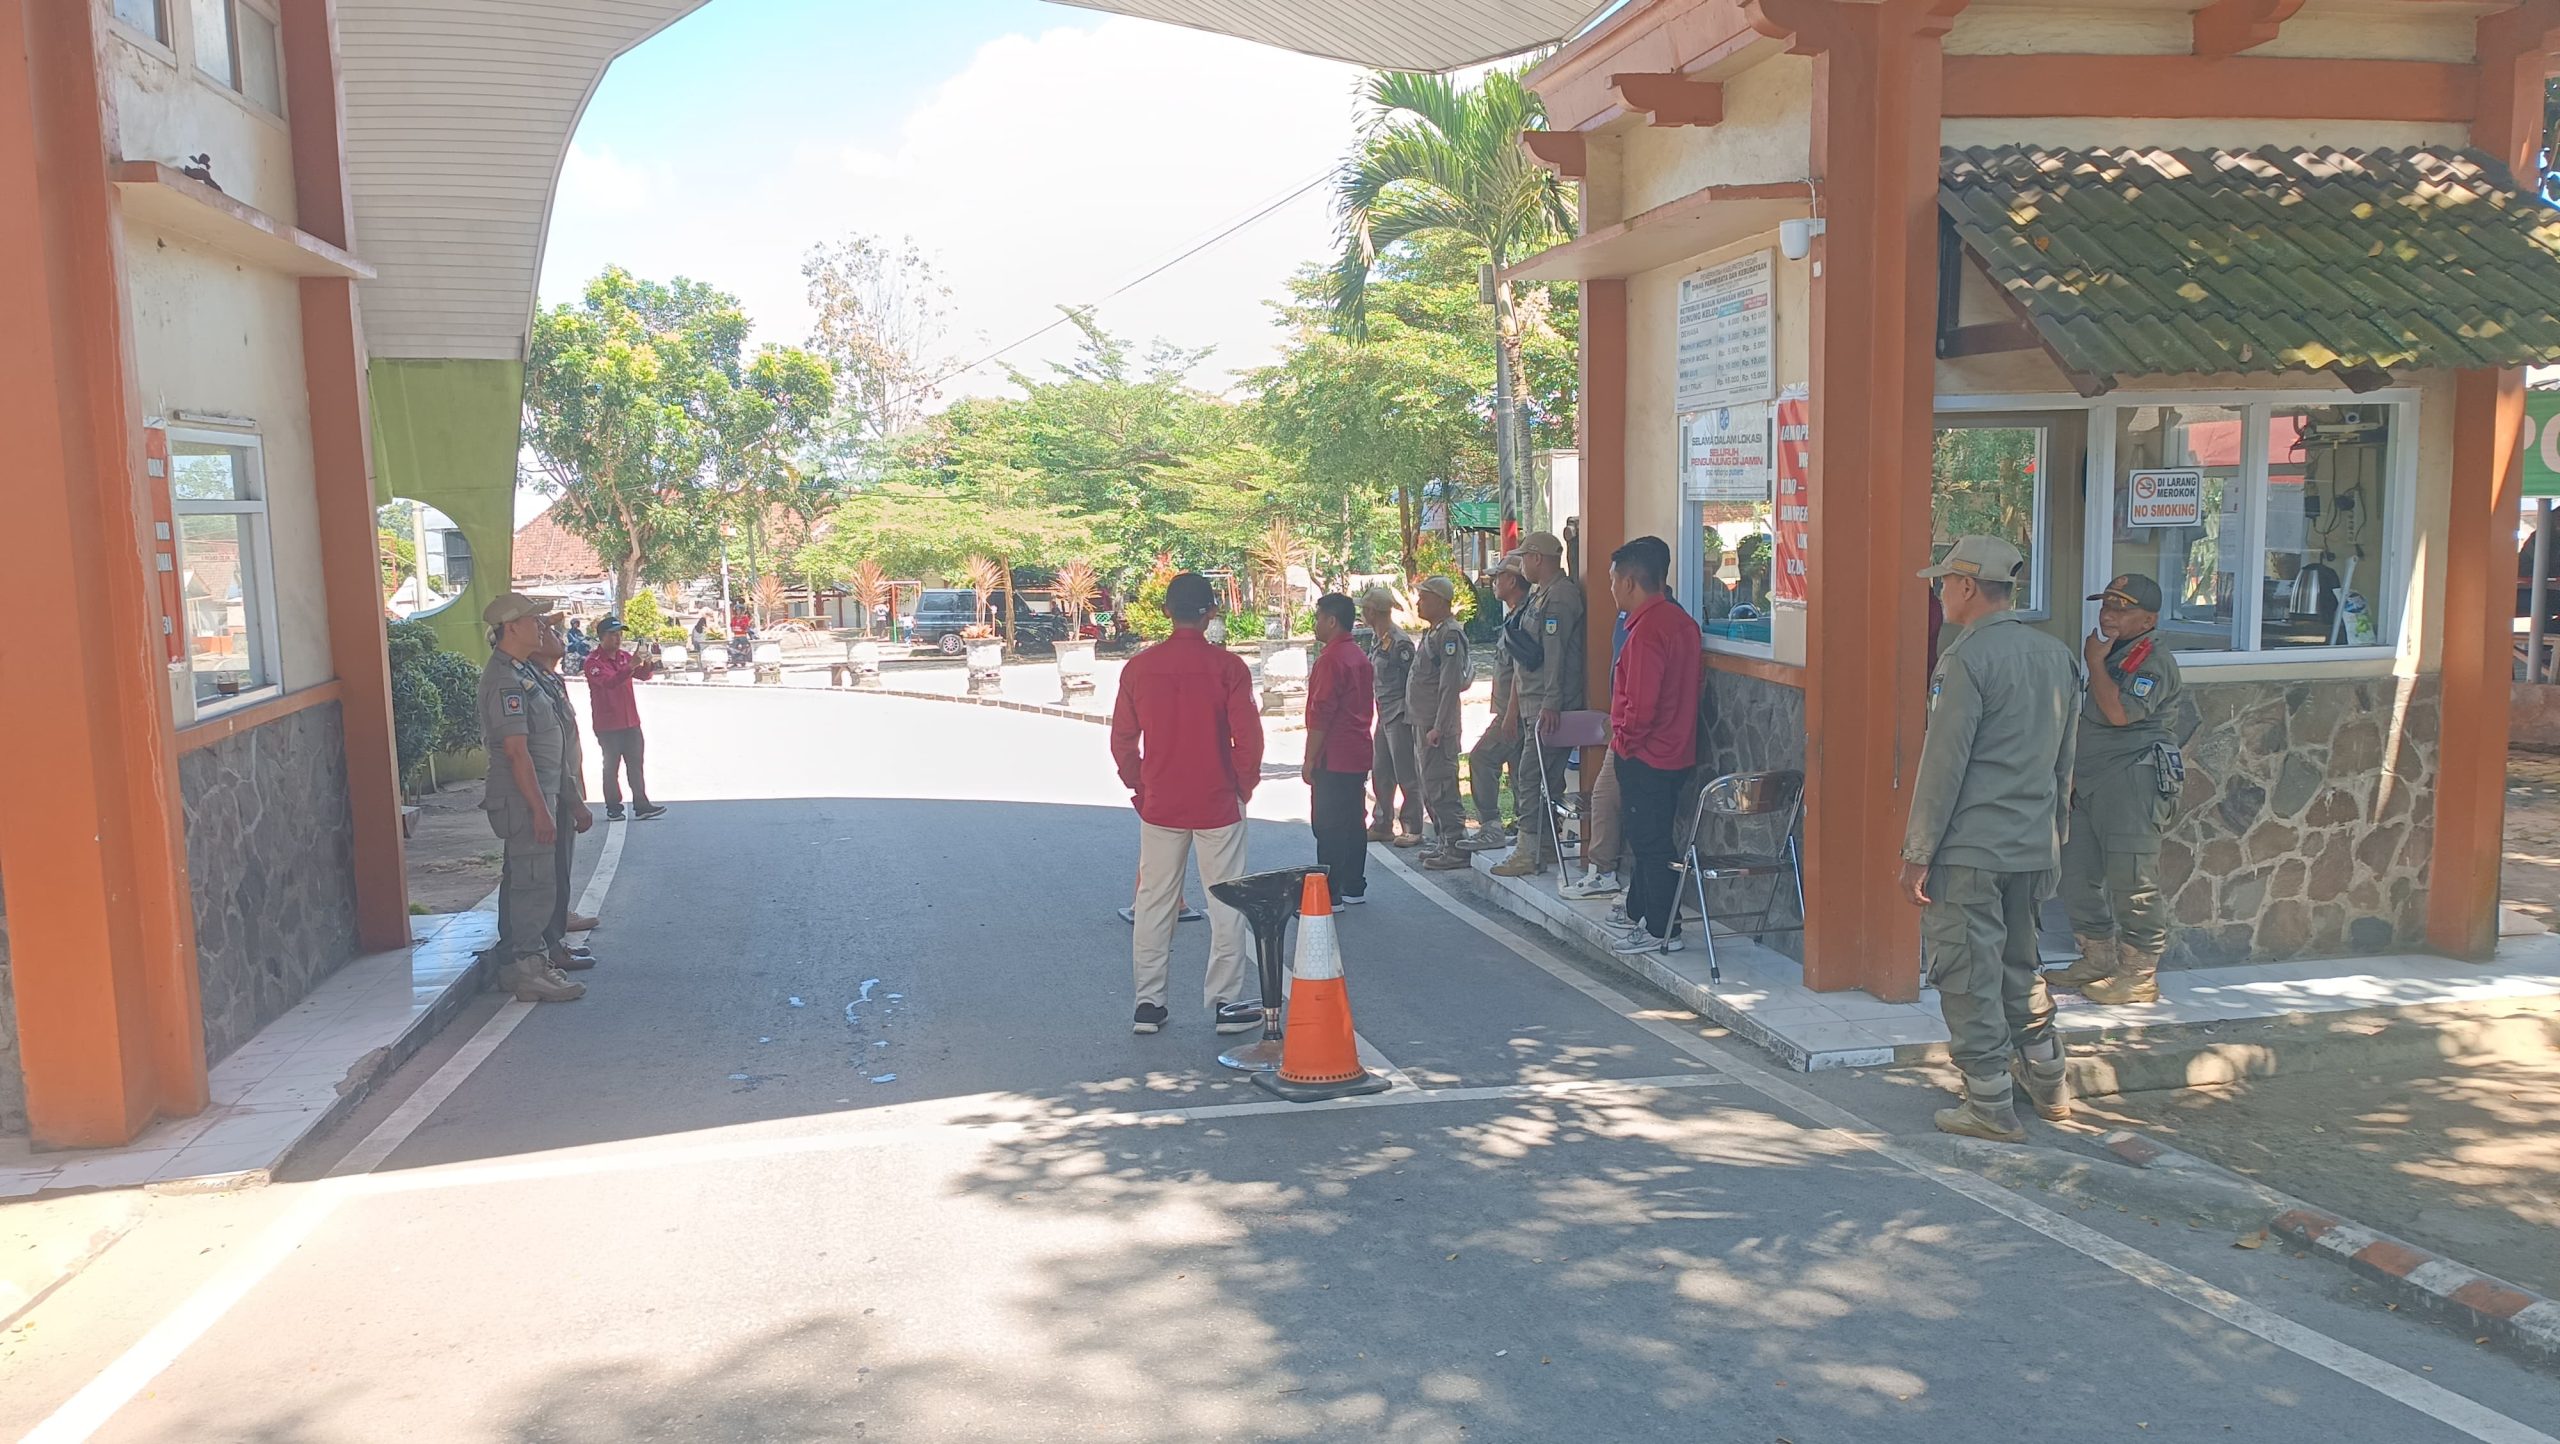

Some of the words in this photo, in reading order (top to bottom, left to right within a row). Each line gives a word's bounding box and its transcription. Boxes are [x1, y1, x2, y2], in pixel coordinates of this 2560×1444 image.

[1714, 435, 1736, 445] DALAM
[1738, 433, 1762, 444] LOKASI
[1710, 448, 1739, 457] SELURUH
[1740, 456, 1763, 466] JAMIN
[2157, 478, 2165, 487] DI
[2167, 477, 2197, 487] LARANG
[2157, 488, 2196, 498] MEROKOK
[2134, 505, 2148, 518] NO
[2151, 503, 2195, 517] SMOKING
